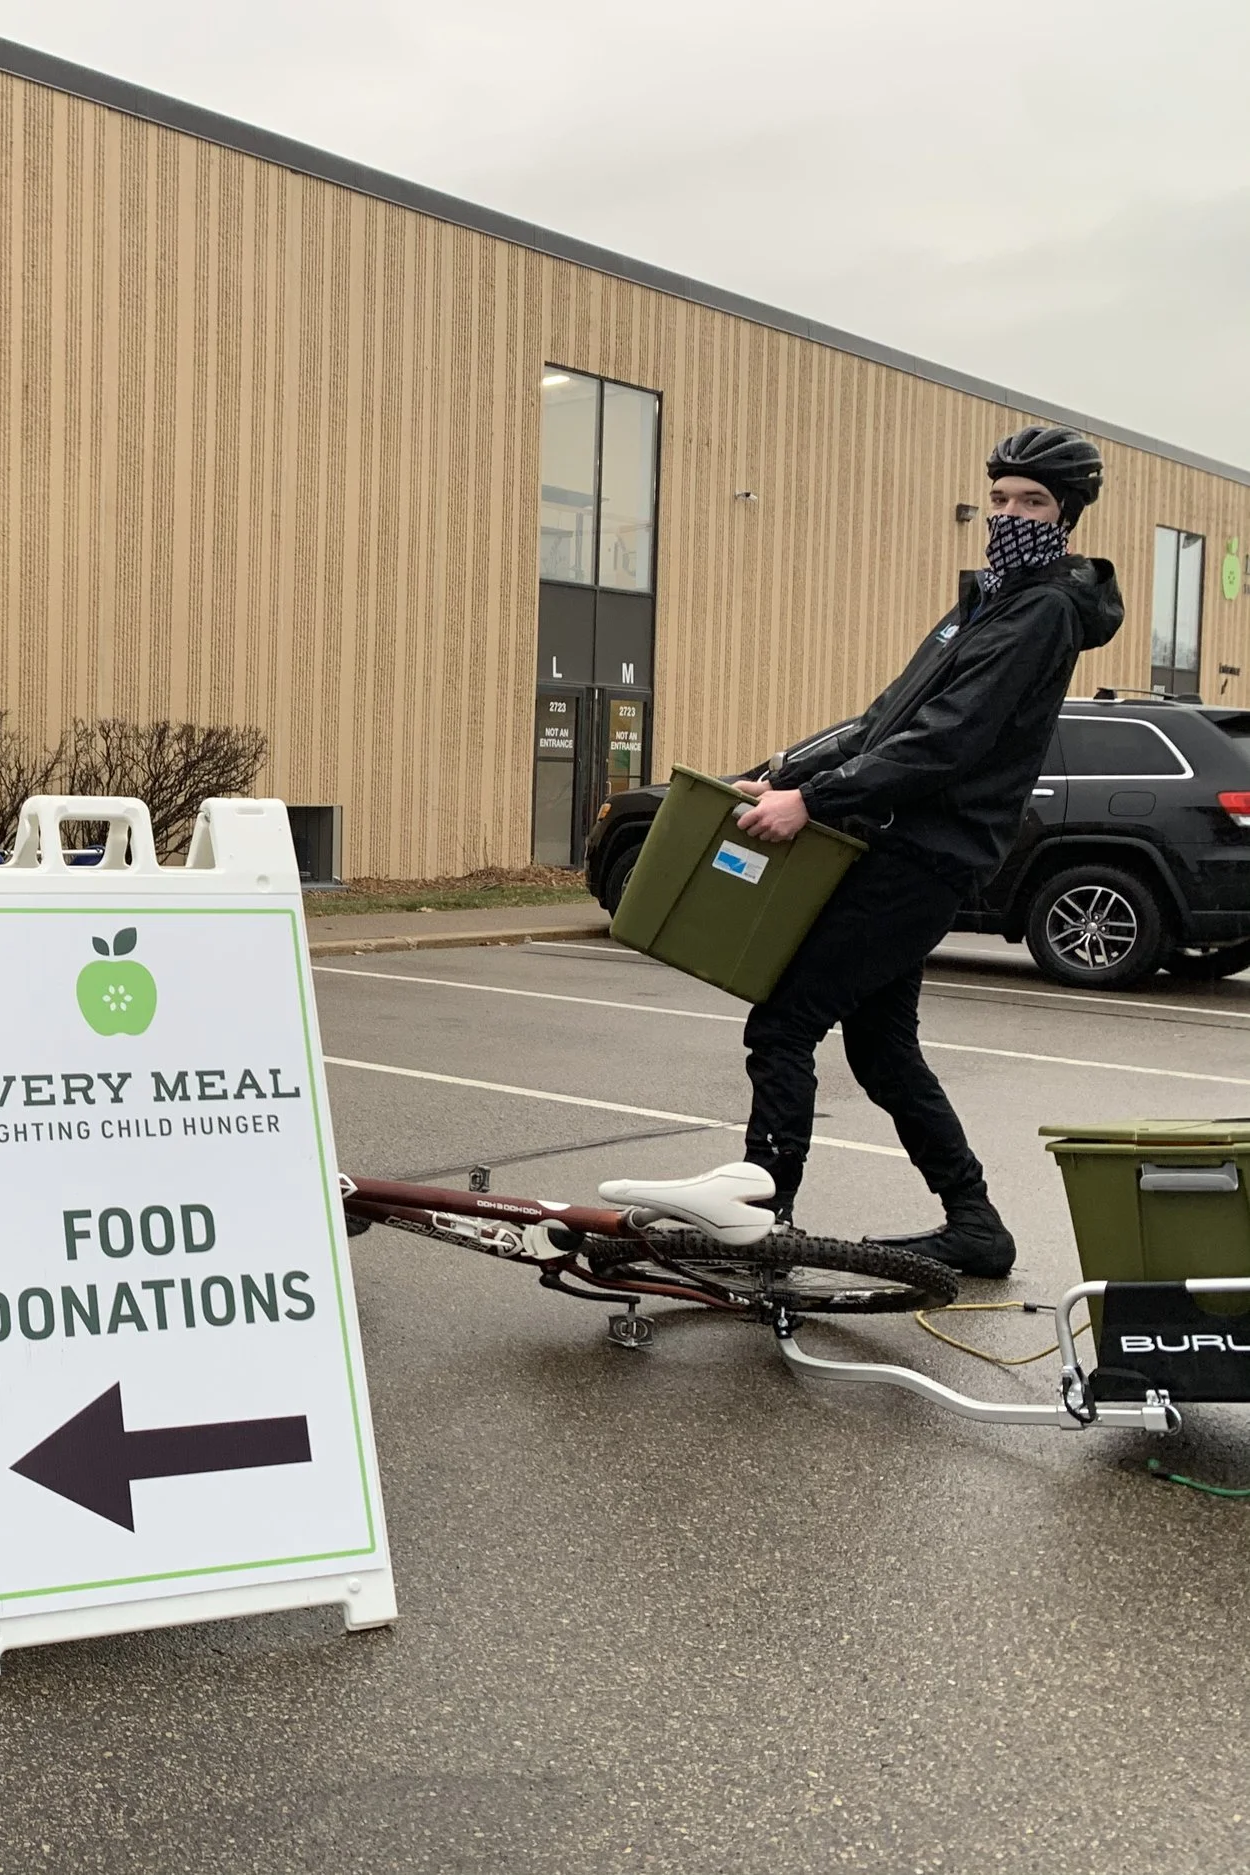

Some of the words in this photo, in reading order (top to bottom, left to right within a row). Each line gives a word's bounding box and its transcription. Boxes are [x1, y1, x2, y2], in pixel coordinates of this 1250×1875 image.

[553, 656, 562, 678] L
[622, 662, 634, 684] M
[549, 701, 567, 713] 2723
[619, 706, 636, 717] 2723
[545, 728, 559, 737] NOT
[559, 728, 569, 738] AN
[615, 731, 628, 740] NOT
[629, 731, 638, 740] AN
[539, 738, 573, 749] ENTRANCE
[610, 742, 642, 751] ENTRANCE
[150, 1068, 301, 1103] MEAL
[101, 1116, 173, 1139] CHILD
[182, 1114, 281, 1137] HUNGER
[62, 1203, 217, 1261] FOOD
